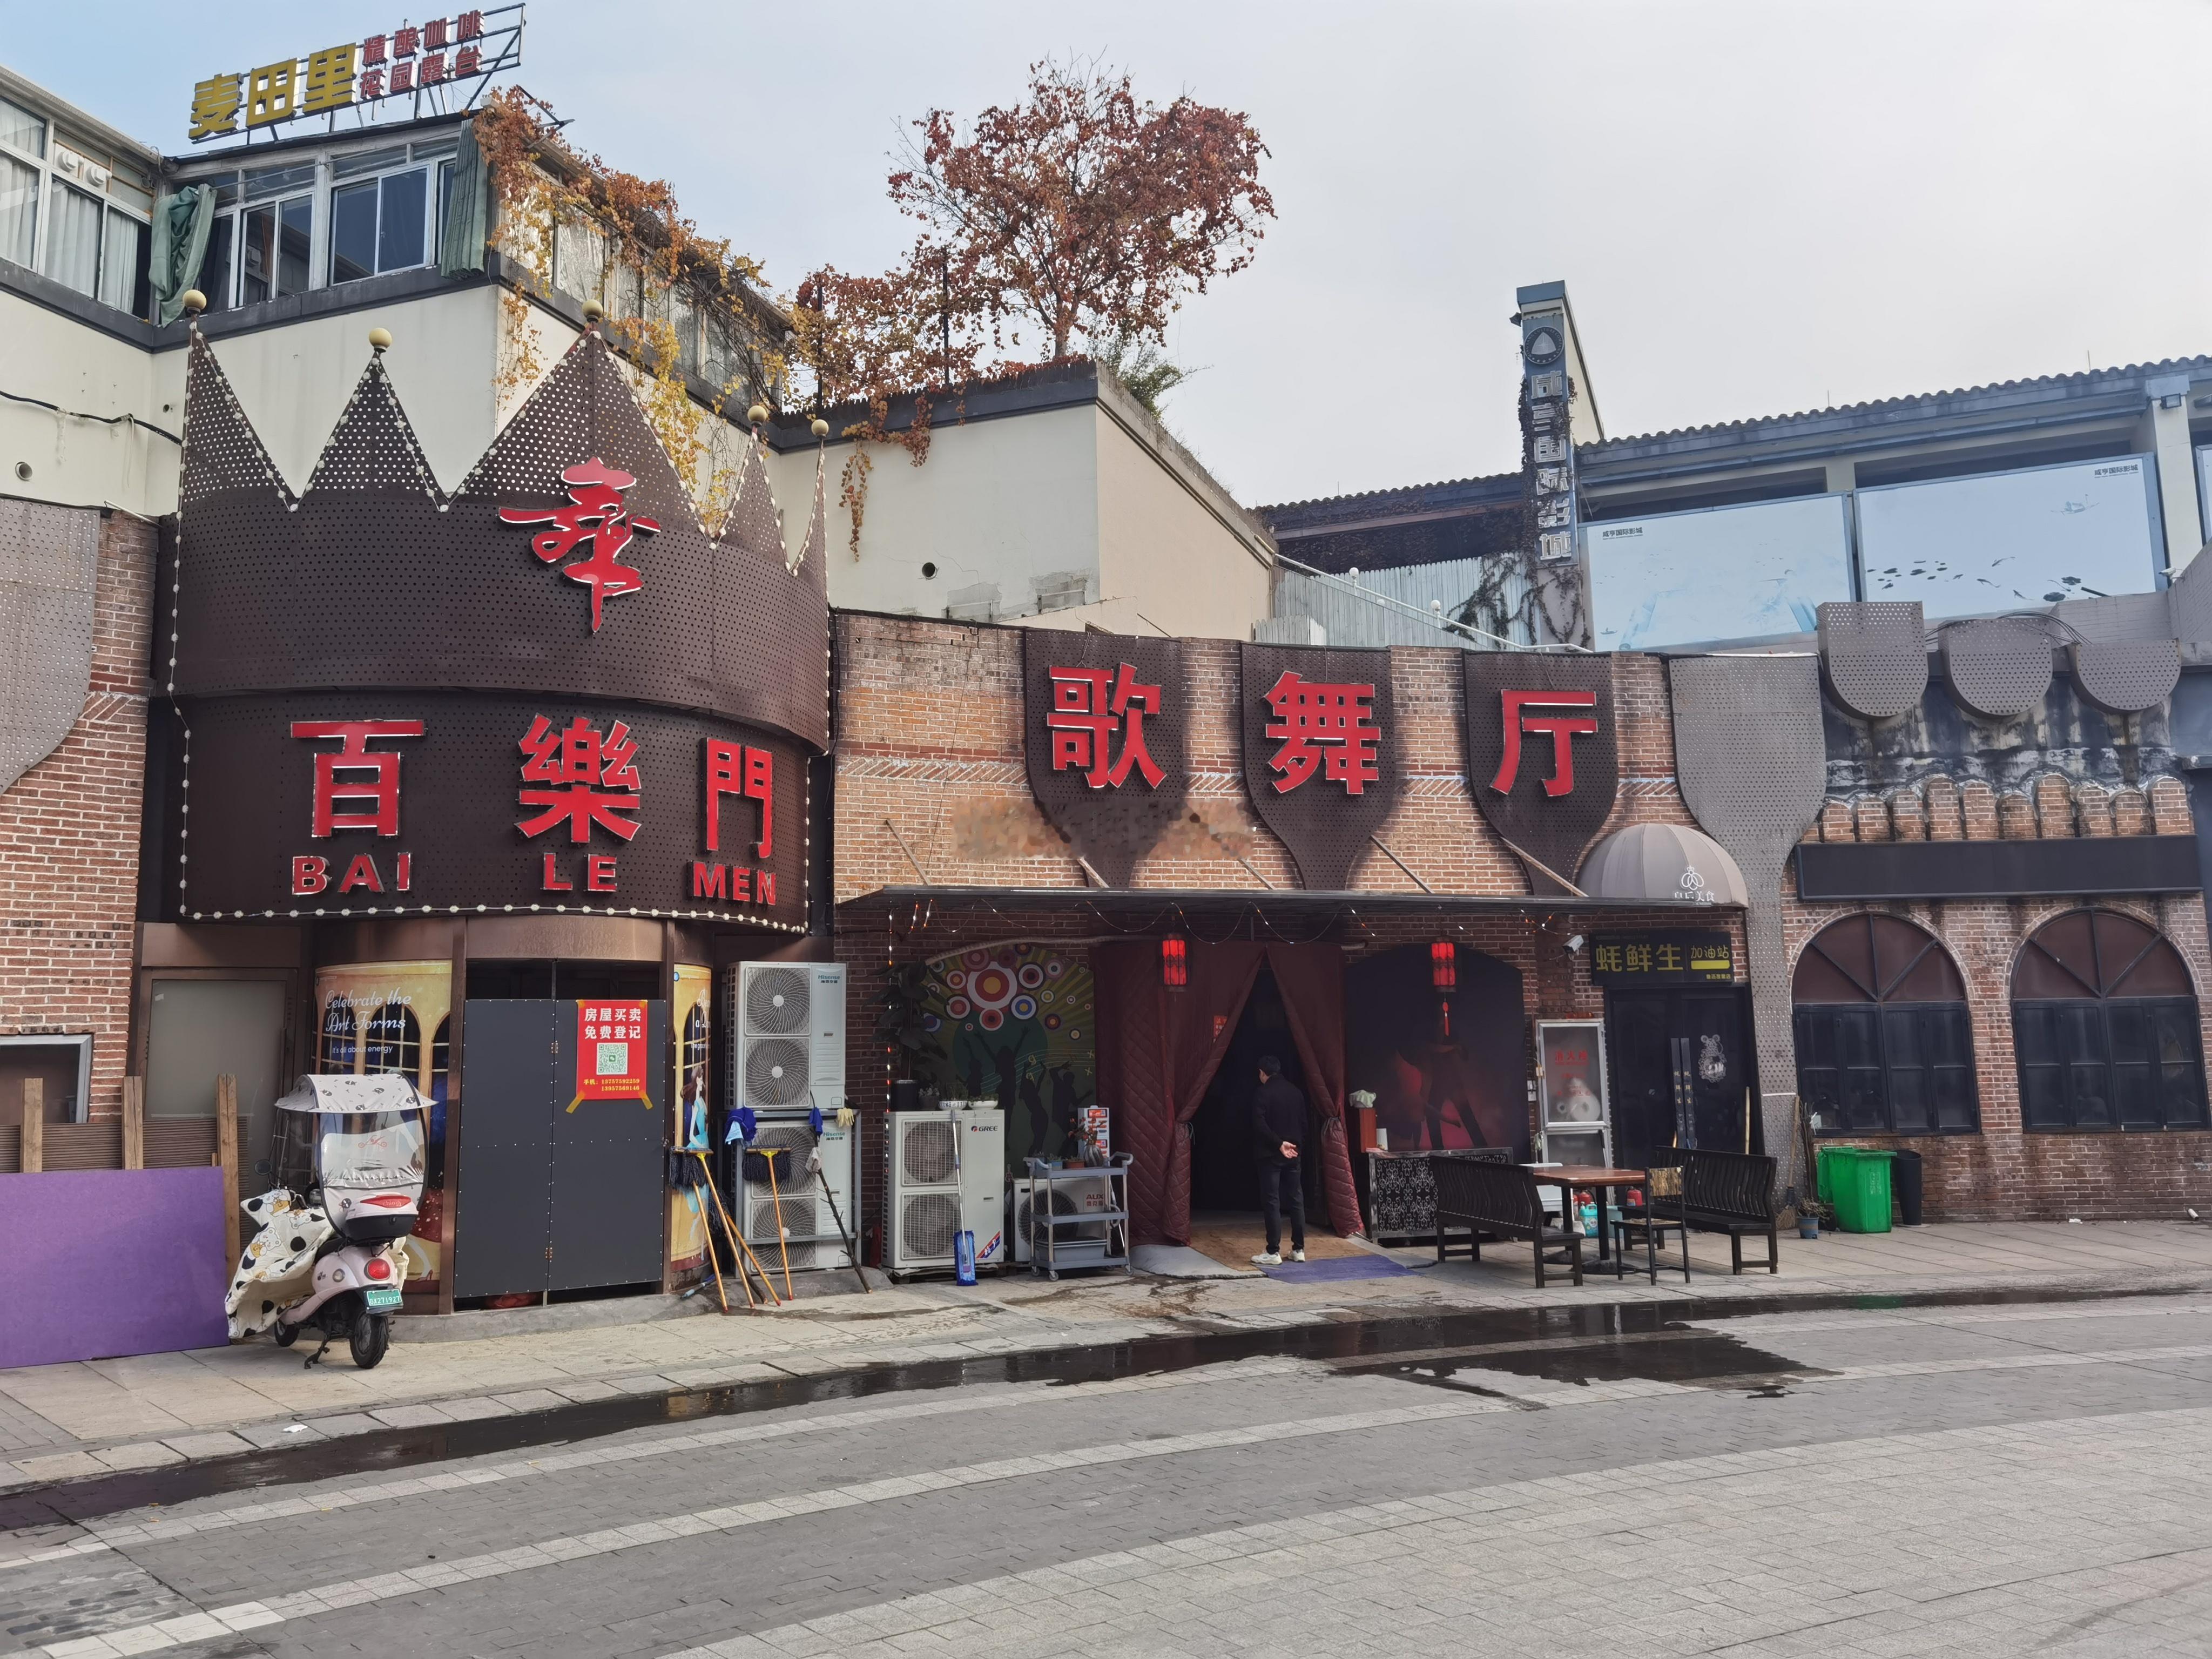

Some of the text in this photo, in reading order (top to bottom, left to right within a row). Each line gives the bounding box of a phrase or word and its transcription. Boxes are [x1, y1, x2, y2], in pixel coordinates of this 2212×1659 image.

[362, 10, 484, 67] 精酿咖啡
[359, 45, 483, 99] 花园露台
[188, 42, 358, 139] 麦田里
[2094, 464, 2139, 475] 咸亨国际影城
[1602, 527, 1643, 537] 咸亨国际影城
[1046, 662, 1599, 798] 歌舞厅
[290, 713, 773, 860] 百樂門
[291, 852, 778, 907] BAI LE MEN
[1596, 943, 1684, 972] 蚝鲜生
[1691, 945, 1729, 959] 加油站
[325, 987, 412, 1009] Celebrate the
[326, 1010, 406, 1032] Art Forms
[584, 1008, 642, 1022] 房屋买卖
[584, 1025, 642, 1040] 免费登记
[367, 1045, 393, 1054] energy
